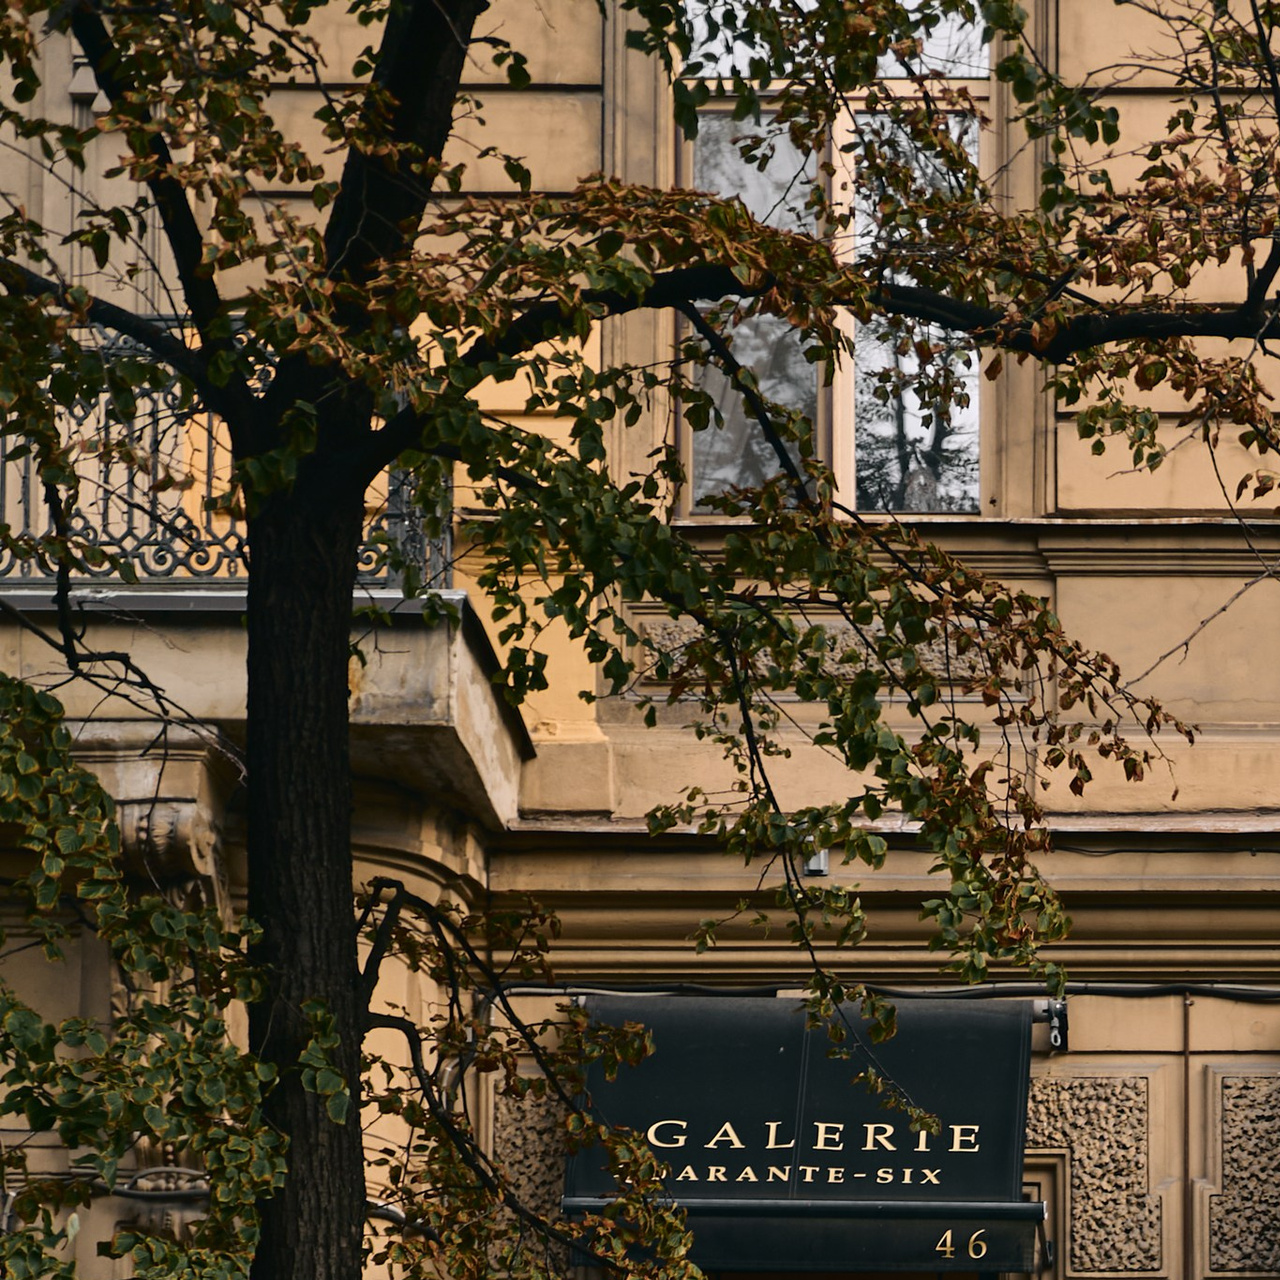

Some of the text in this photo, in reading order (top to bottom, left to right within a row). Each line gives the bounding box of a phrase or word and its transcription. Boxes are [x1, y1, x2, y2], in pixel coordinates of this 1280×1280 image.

[647, 1119, 981, 1154] GALERIE
[613, 1164, 943, 1185] ARANTE-SIX
[935, 1229, 987, 1259] 46
